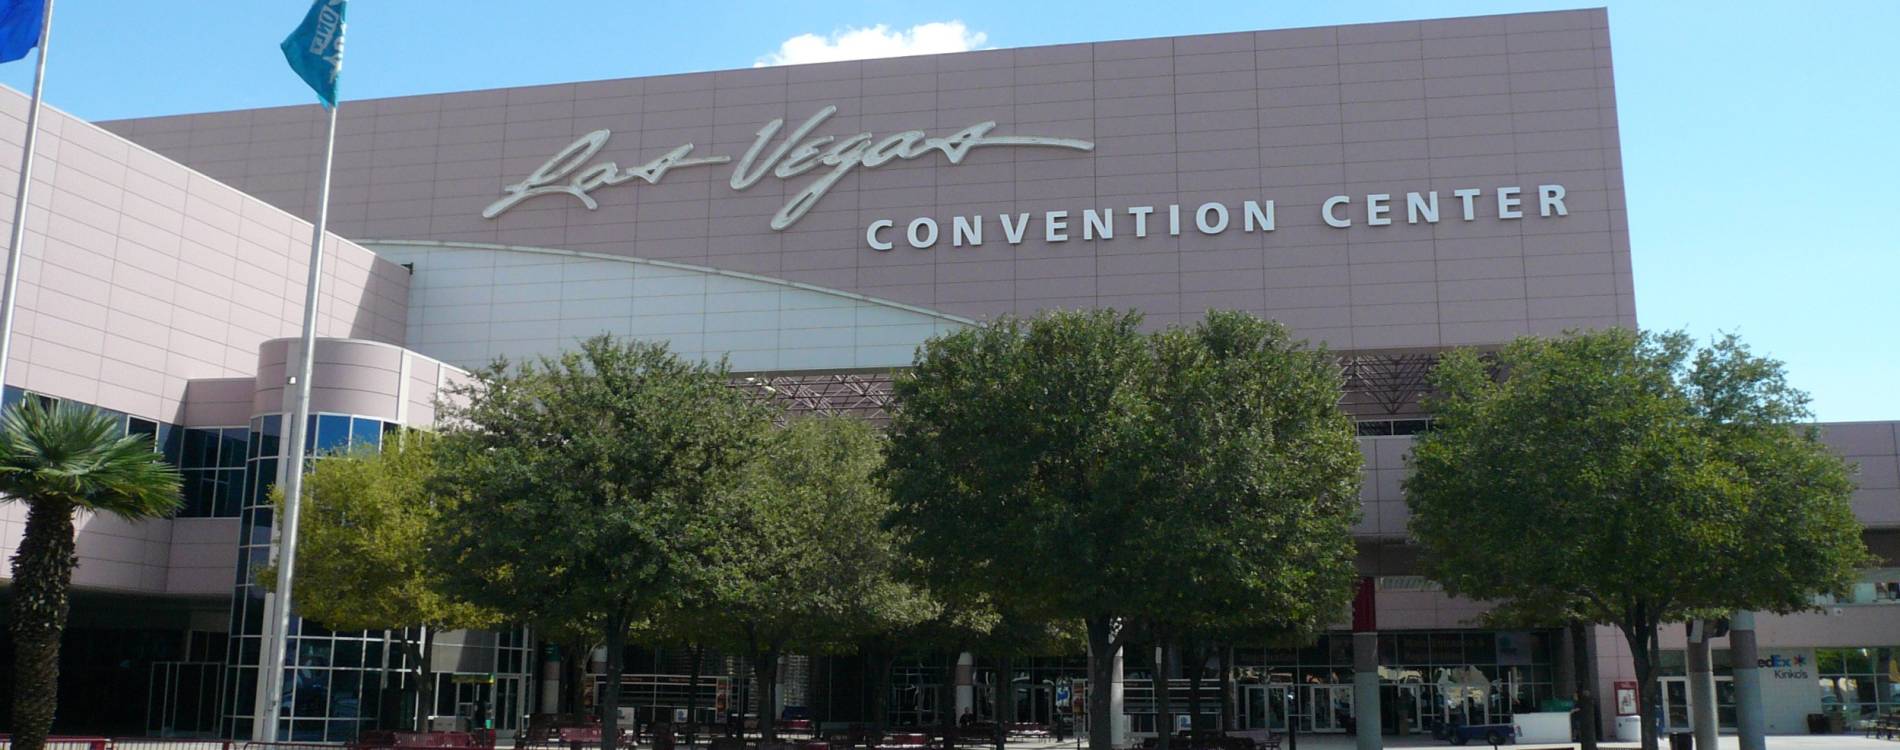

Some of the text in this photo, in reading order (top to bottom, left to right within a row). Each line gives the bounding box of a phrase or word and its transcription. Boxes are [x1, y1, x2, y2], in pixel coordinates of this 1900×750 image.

[483, 105, 1095, 230] Las Vegas
[866, 184, 1569, 251] CONVENTION CENTER
[1757, 654, 1791, 668] edEx
